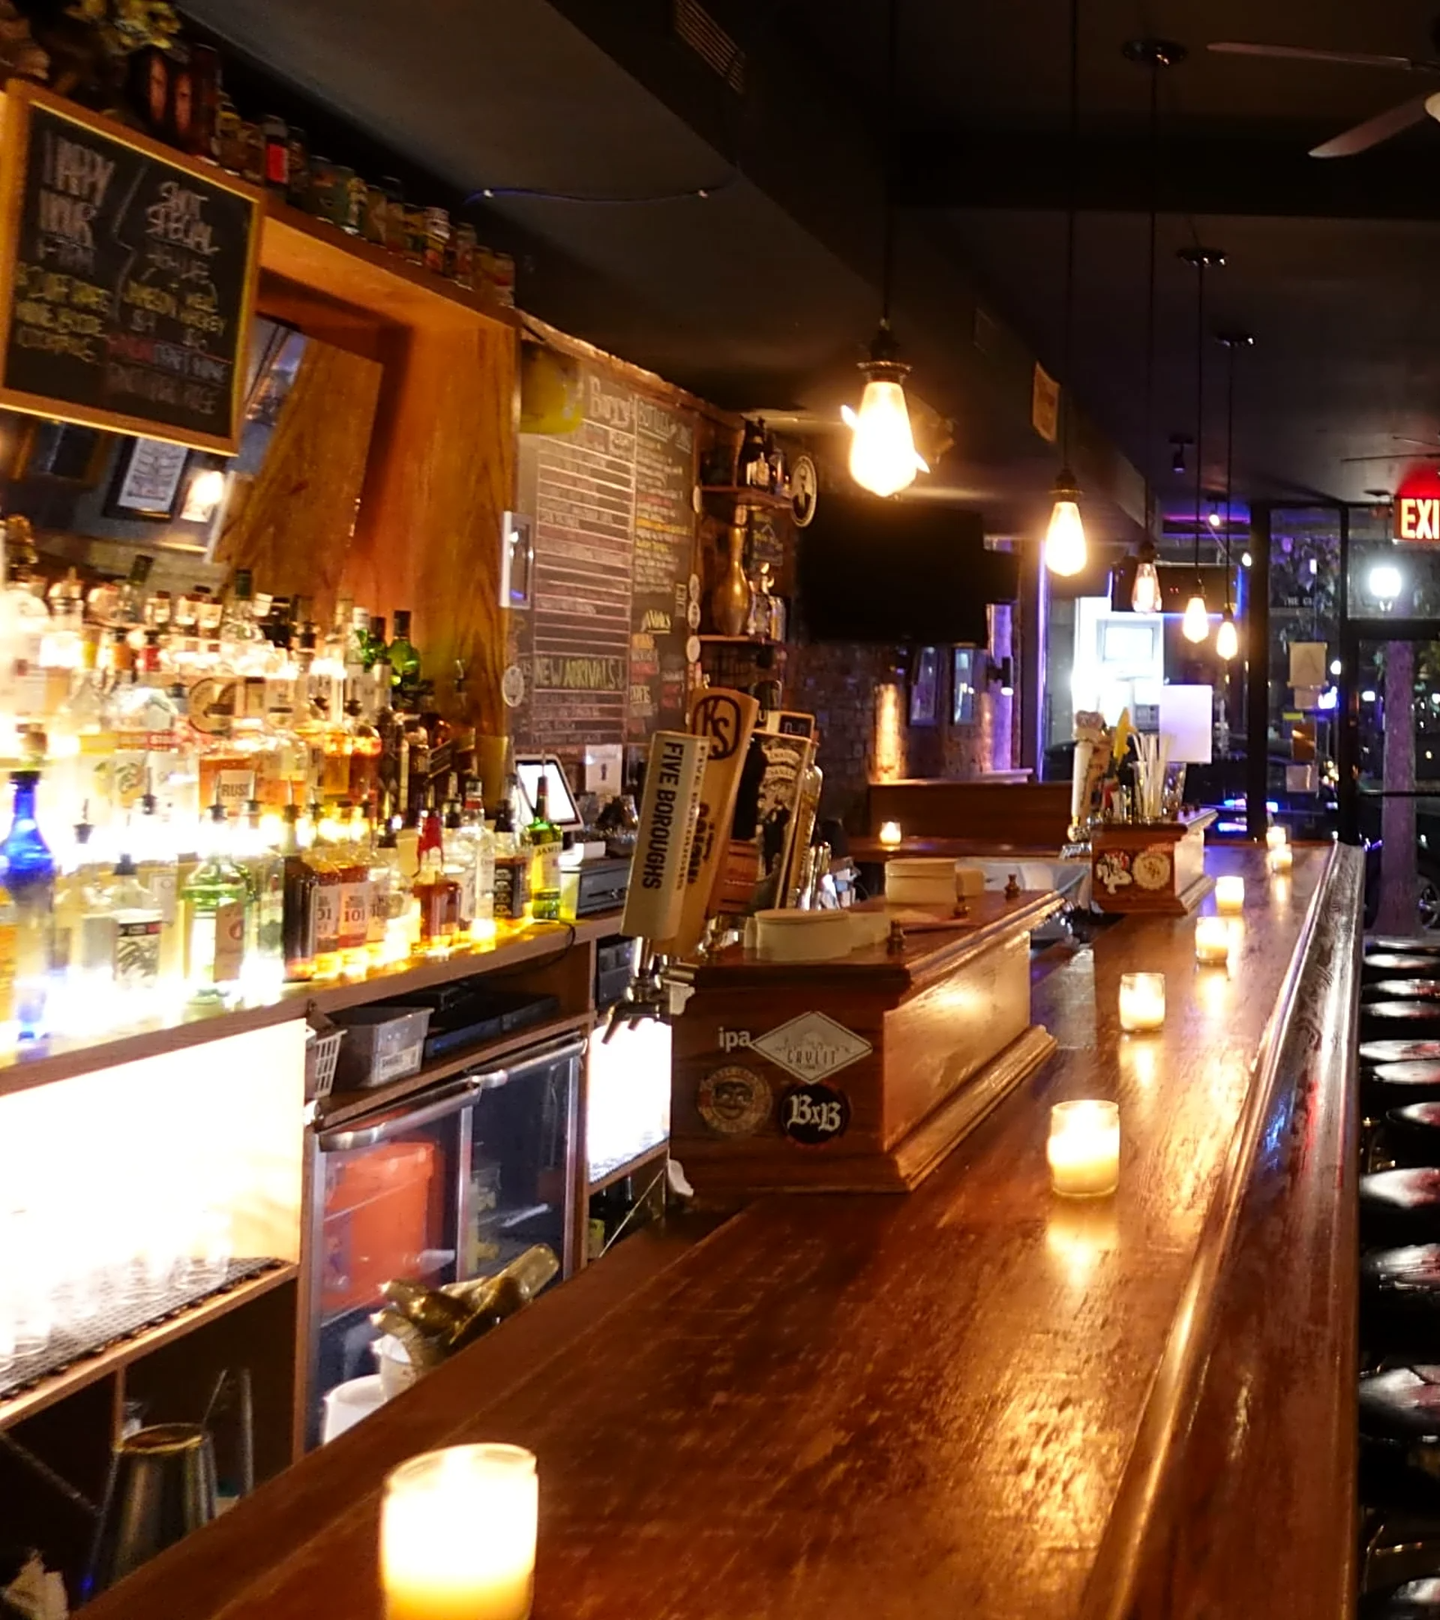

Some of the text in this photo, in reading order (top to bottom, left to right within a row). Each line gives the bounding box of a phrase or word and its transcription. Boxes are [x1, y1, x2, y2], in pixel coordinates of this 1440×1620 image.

[535, 657, 563, 689] NEW
[659, 741, 685, 787] FIVE
[642, 788, 677, 890] BOROUGHS
[718, 1026, 751, 1052] ipa
